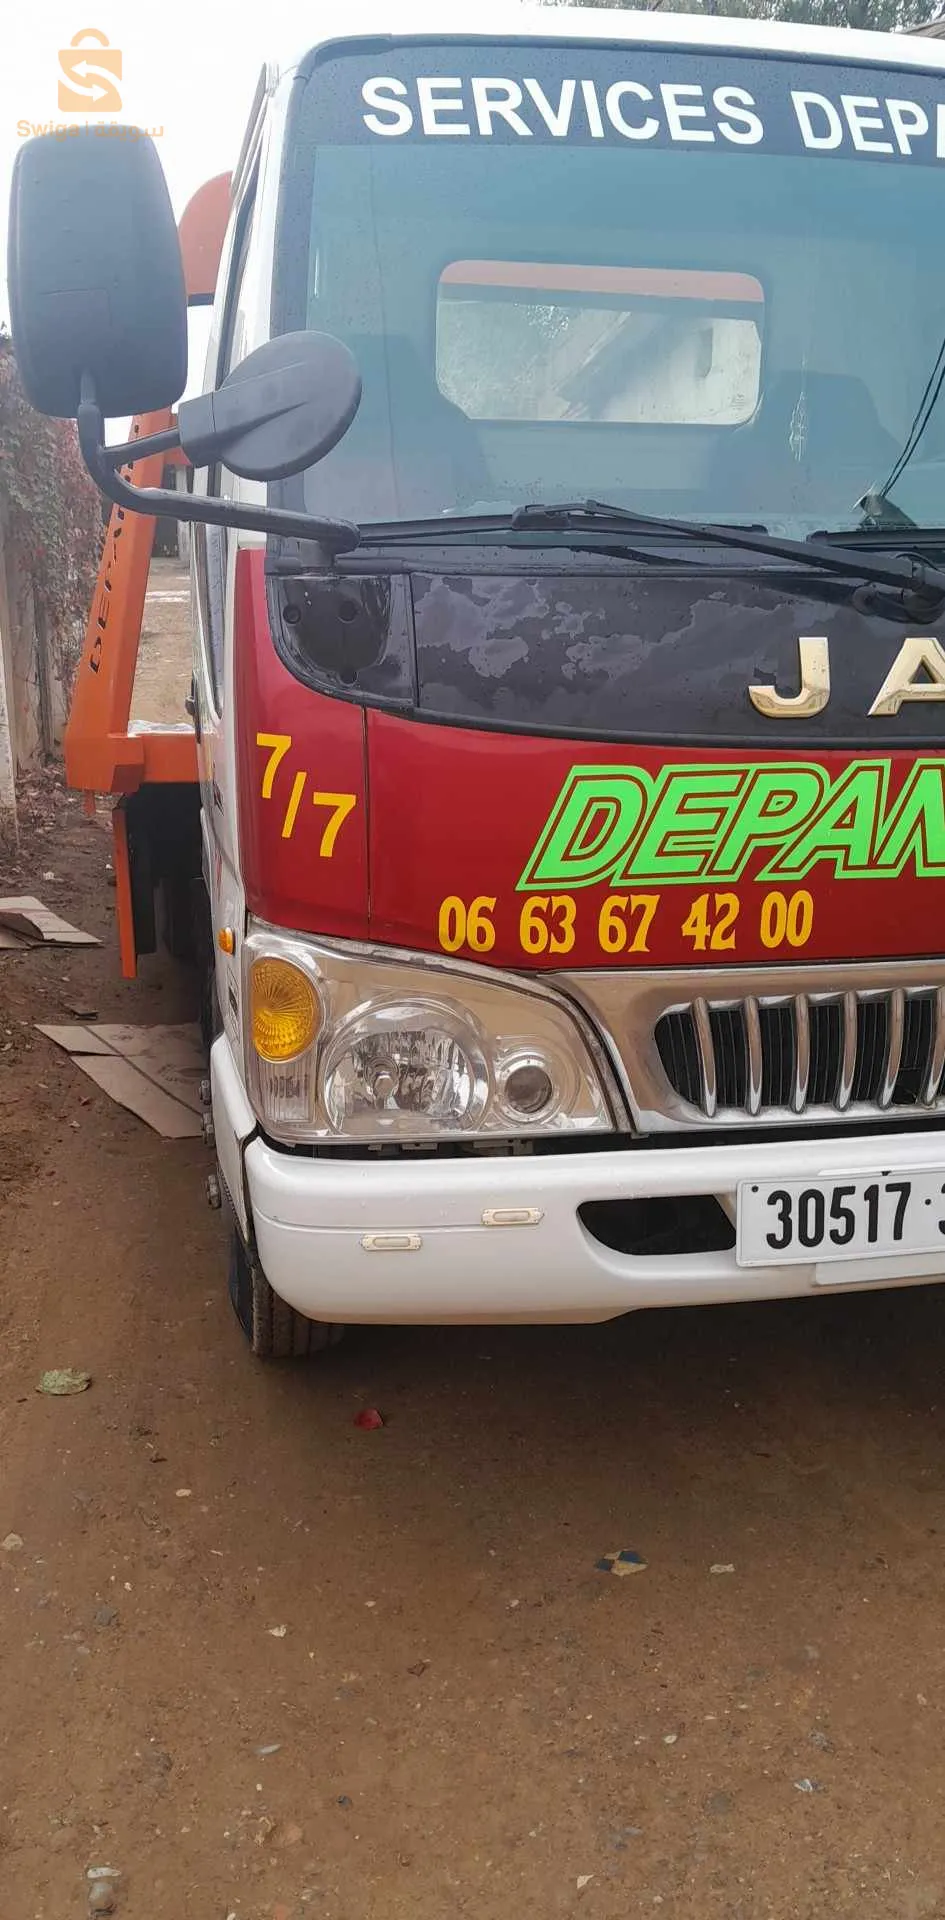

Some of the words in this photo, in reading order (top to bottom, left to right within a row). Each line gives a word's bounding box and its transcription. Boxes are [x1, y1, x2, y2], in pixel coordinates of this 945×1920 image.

[361, 76, 764, 144] SERVICES
[790, 91, 945, 158] DEP
[256, 733, 357, 857] 7/7
[438, 896, 496, 952] 06
[519, 896, 577, 954] 63
[598, 894, 660, 953] 67
[682, 893, 740, 951] 42
[760, 890, 814, 948] 00
[766, 1182, 911, 1249] 30517
